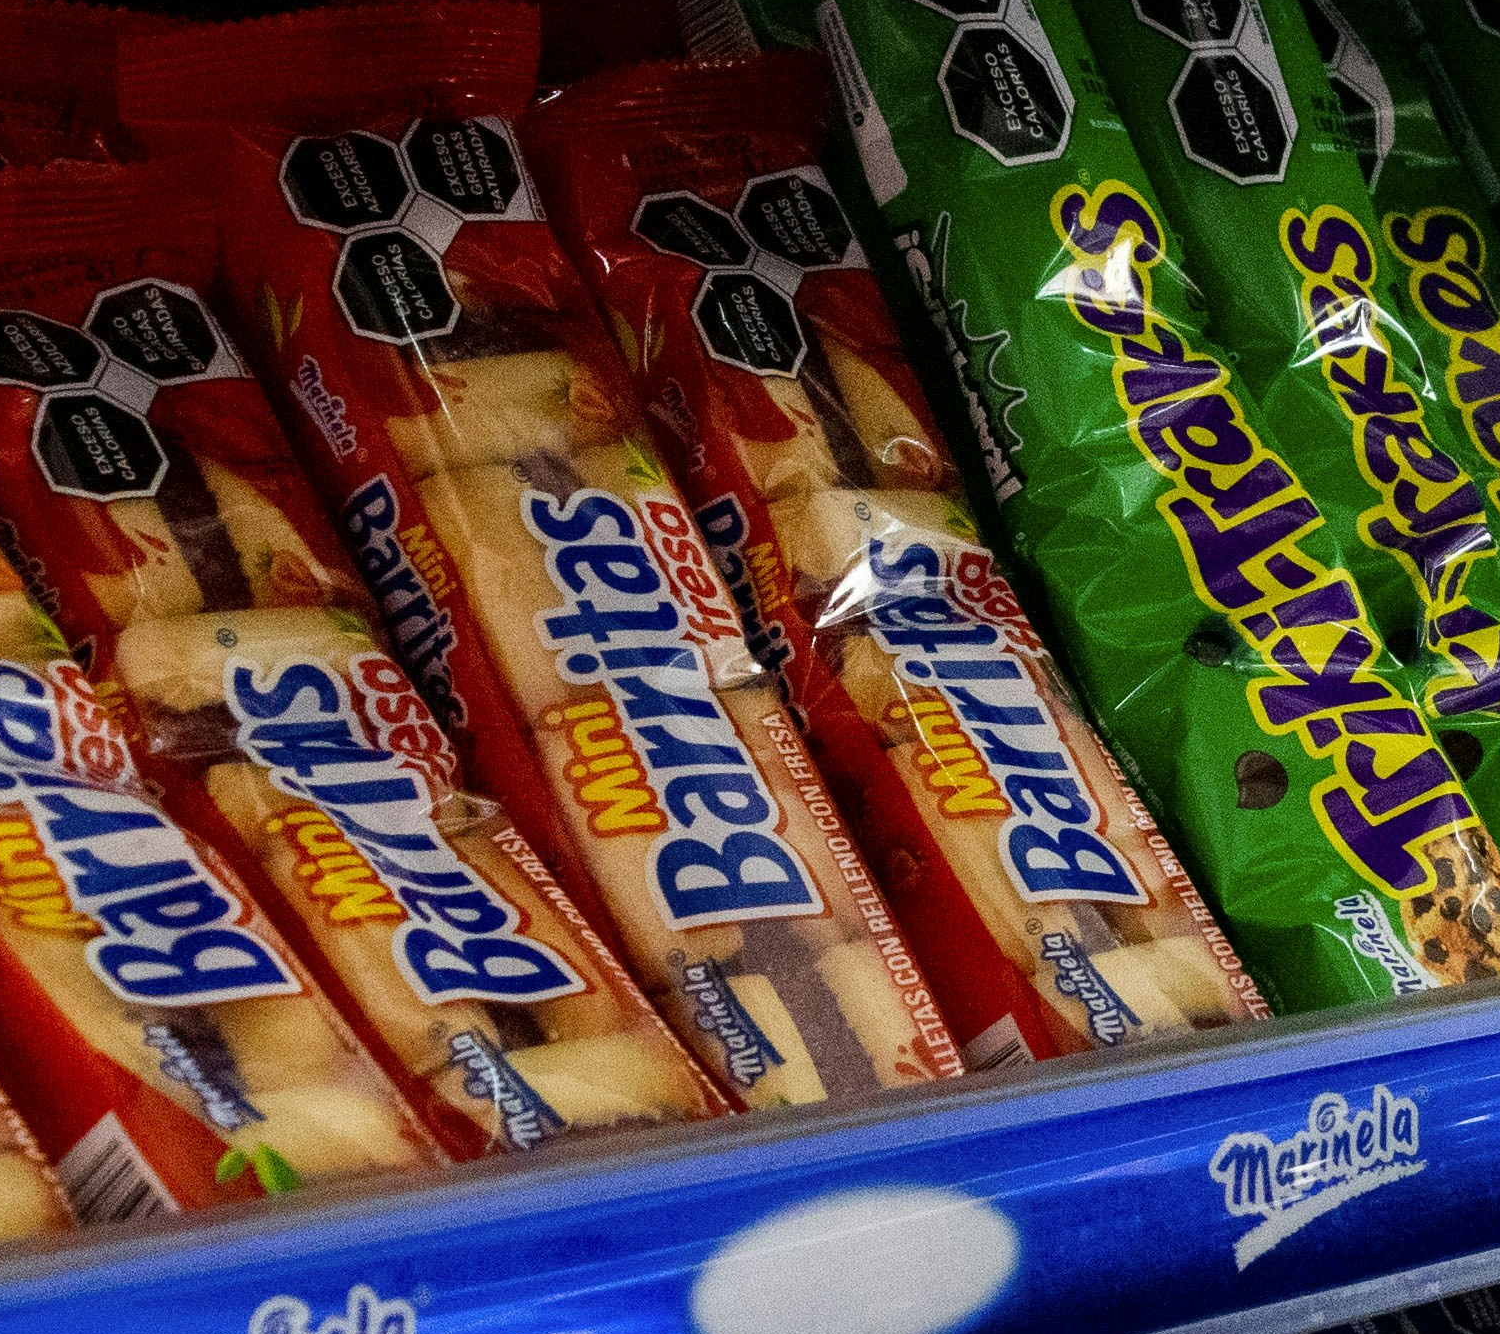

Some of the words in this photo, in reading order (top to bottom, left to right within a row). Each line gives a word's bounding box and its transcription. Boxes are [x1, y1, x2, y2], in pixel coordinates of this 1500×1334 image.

[984, 50, 1024, 134] EXCESO
[996, 41, 1045, 141] CALORIAS
[1212, 76, 1252, 157] EXCESO
[1224, 68, 1272, 165] CALORIAS
[317, 148, 361, 210] EXCESO
[335, 137, 384, 216] AZUCARES
[431, 131, 467, 201] EXCESO
[447, 129, 486, 200] GRASAS
[369, 251, 413, 320] EXCESO
[385, 241, 436, 323] CALORIAS
[68, 410, 116, 477] EXCESO
[82, 404, 137, 483] CALORIAS
[398, 524, 459, 601] Mini
[640, 496, 740, 645] fresa
[746, 540, 795, 613] Mini
[1048, 179, 1478, 900] Triki-Trakes
[520, 485, 826, 931] Barritas
[759, 712, 810, 781] FRESA
[538, 698, 666, 836] Mini
[800, 781, 834, 826] CON
[886, 703, 1010, 823] Mini
[267, 805, 406, 927] Mini
[826, 826, 891, 931] RELLENO
[879, 931, 920, 989] CON
[1041, 933, 1145, 1037] Marinela
[678, 956, 787, 1086] Marinela
[448, 1029, 566, 1149] Marinela
[1211, 1084, 1421, 1217] Marinela
